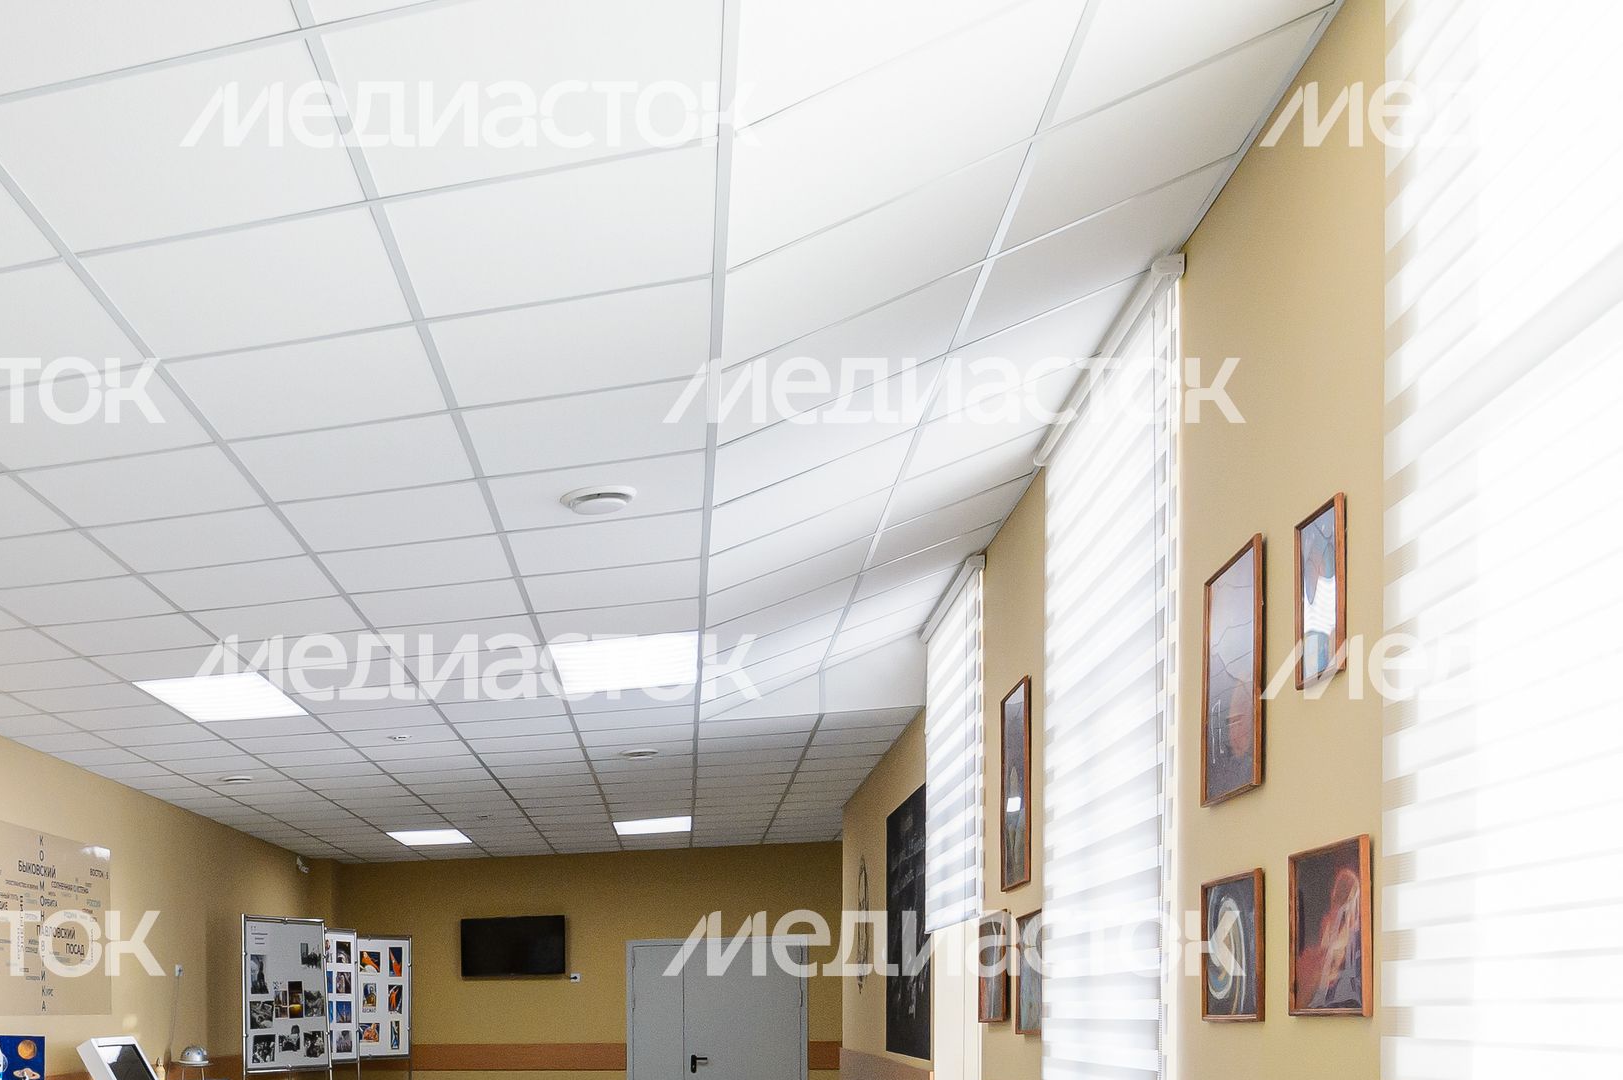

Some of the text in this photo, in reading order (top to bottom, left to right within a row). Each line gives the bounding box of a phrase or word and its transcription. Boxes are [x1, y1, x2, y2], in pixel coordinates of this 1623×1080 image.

[18, 859, 56, 879] БЫКОВСКИЙ
[36, 924, 76, 940] ПАВЛОВСКИЙ
[65, 943, 85, 956] ПОСАД
